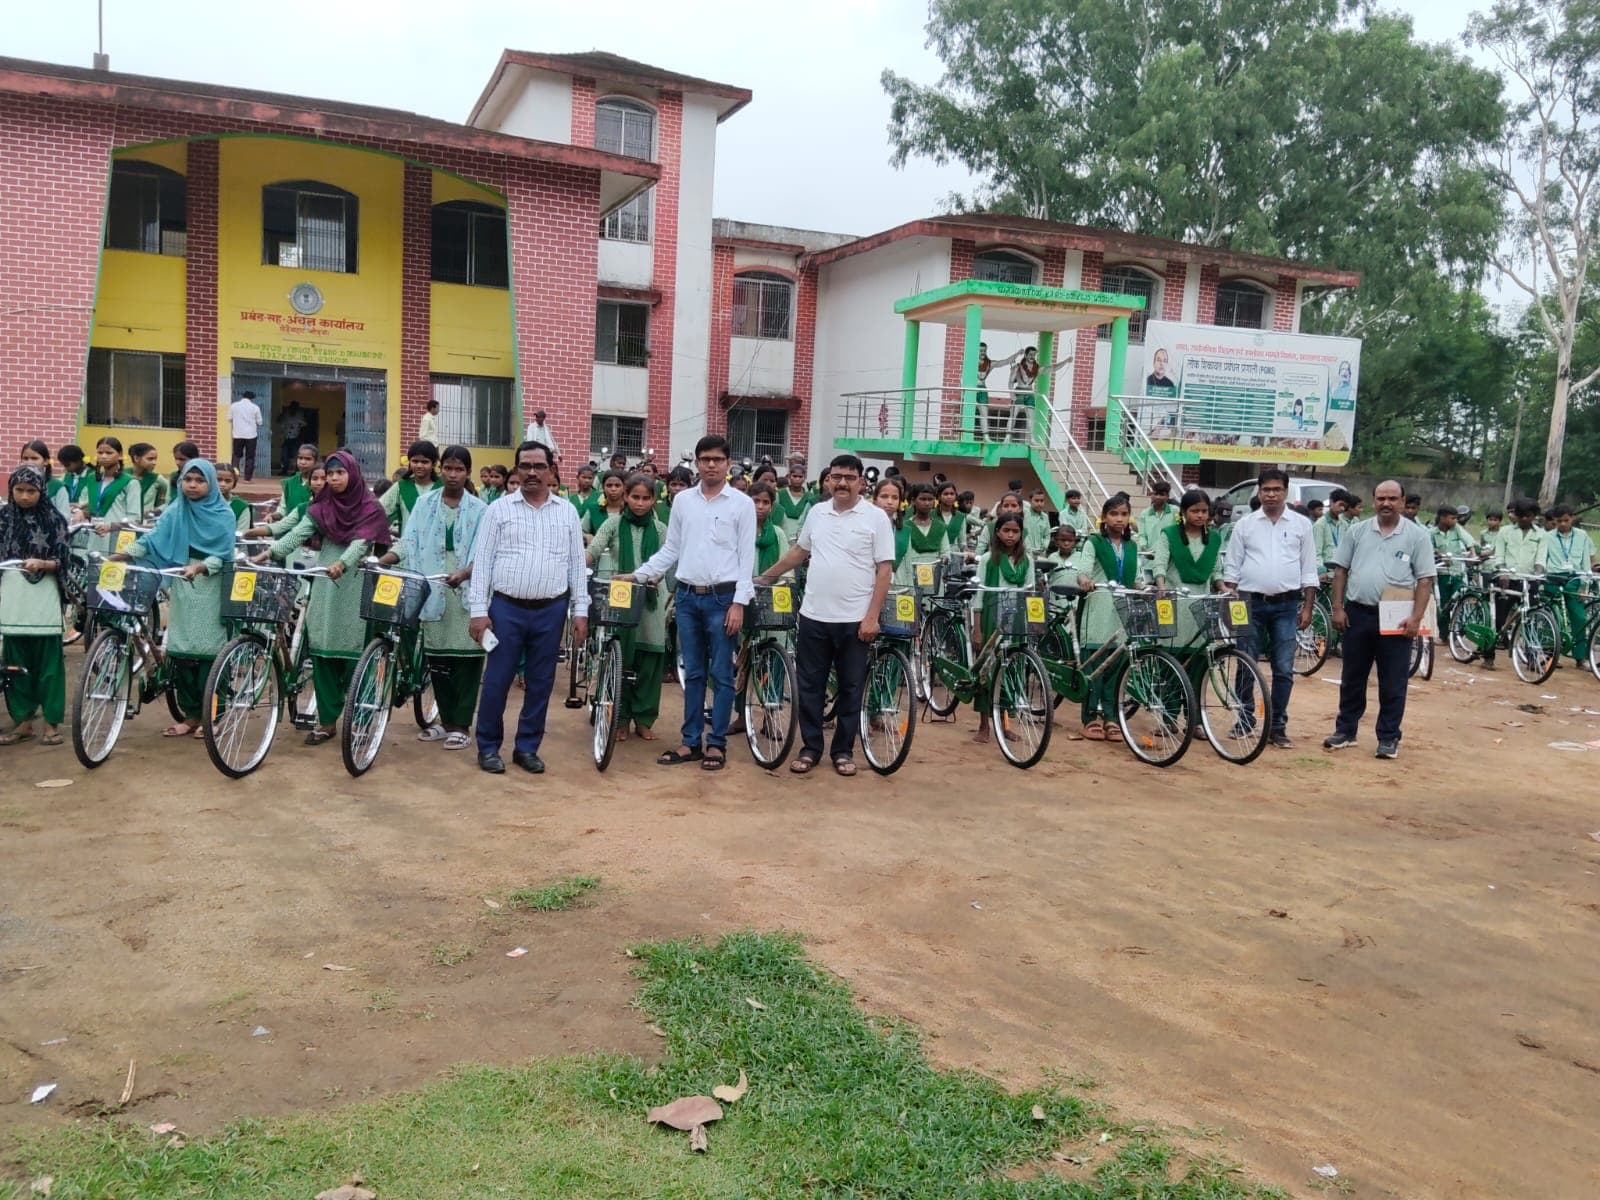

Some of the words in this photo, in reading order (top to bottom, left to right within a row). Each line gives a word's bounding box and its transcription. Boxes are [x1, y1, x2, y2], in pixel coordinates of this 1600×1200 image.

[319, 318, 365, 331] कार्यालय
[1187, 357, 1200, 368] लोक
[1201, 358, 1223, 371] शिकायत
[1241, 361, 1257, 373] प्रणाली
